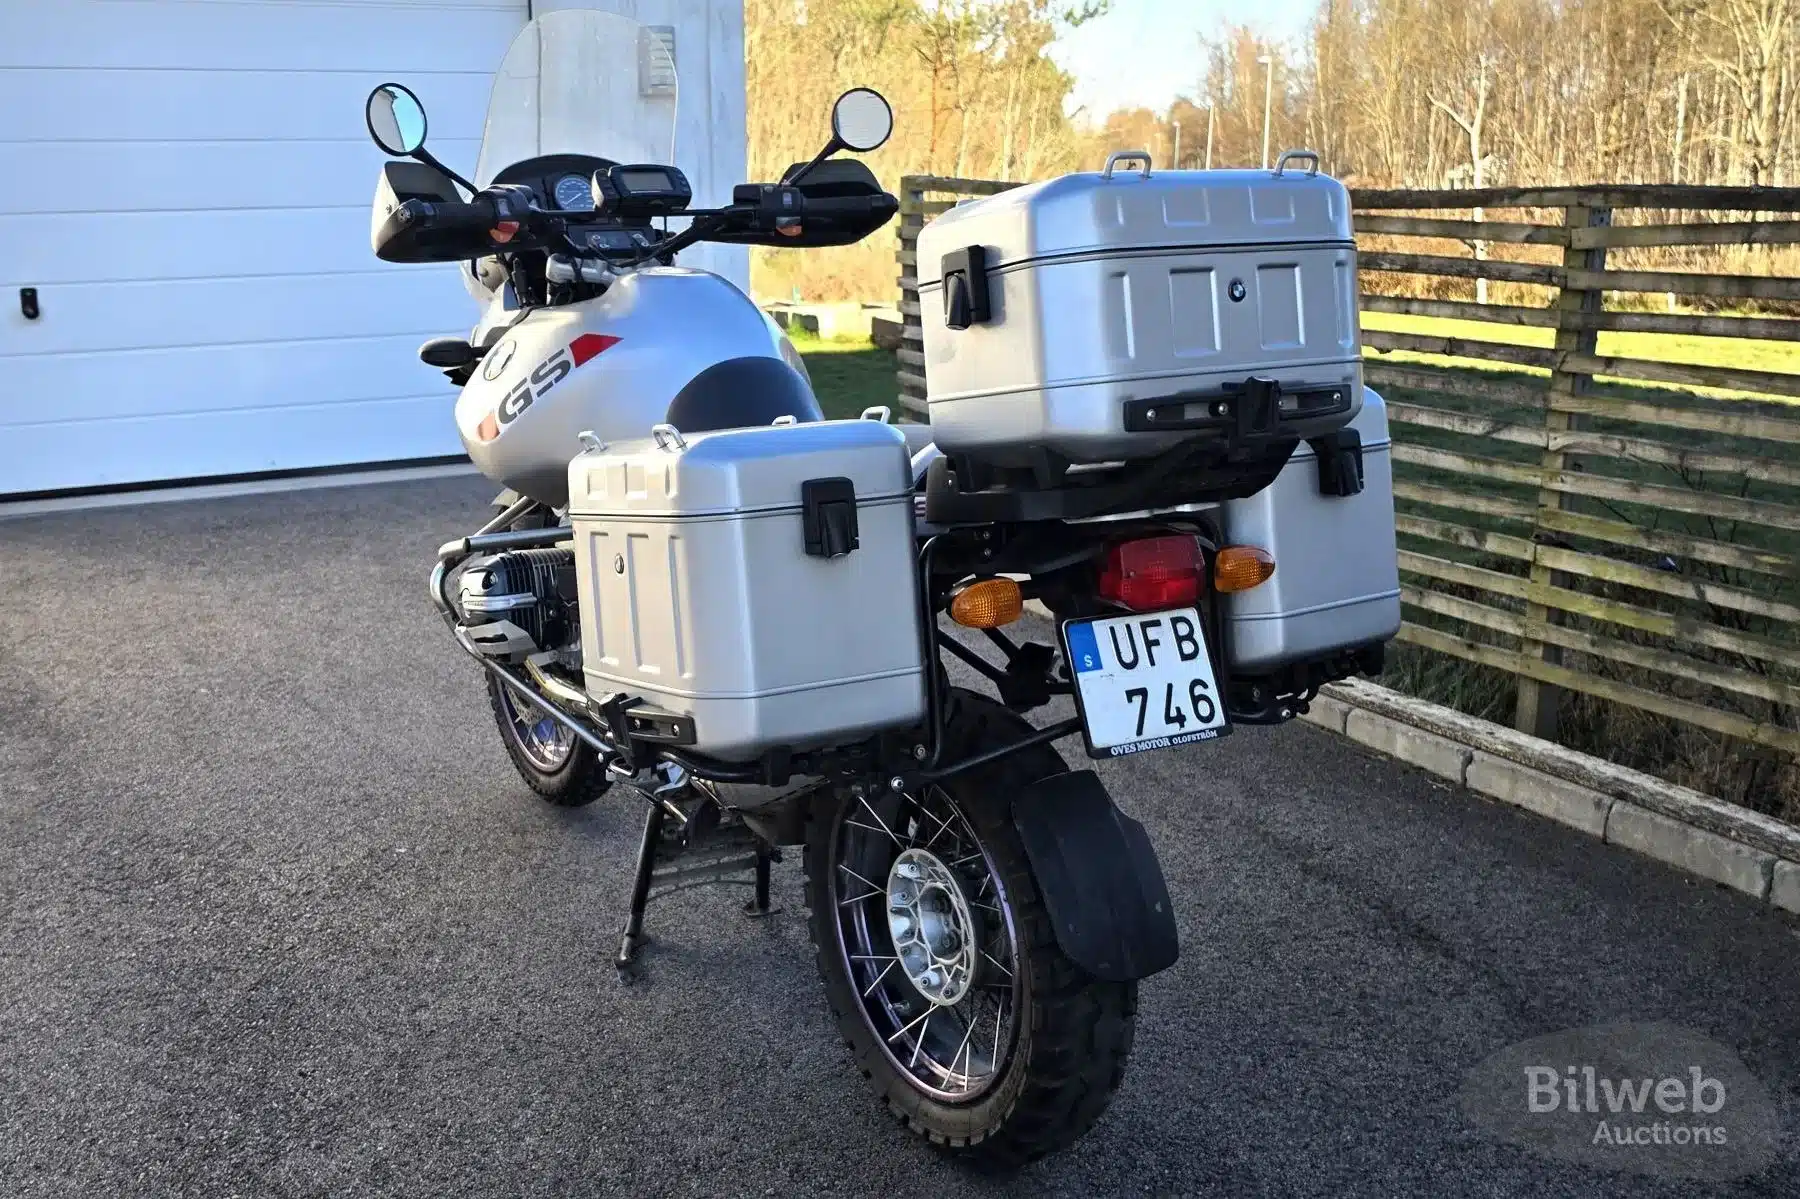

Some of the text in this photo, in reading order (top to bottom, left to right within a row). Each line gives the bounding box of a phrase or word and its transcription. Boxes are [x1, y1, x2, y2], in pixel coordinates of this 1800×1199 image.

[498, 348, 571, 425] GS
[1083, 654, 1093, 668] S
[1109, 616, 1200, 670] UFB
[1124, 678, 1216, 737] 746
[1110, 729, 1218, 756] OVES MOTOR OLOFSTRÖM
